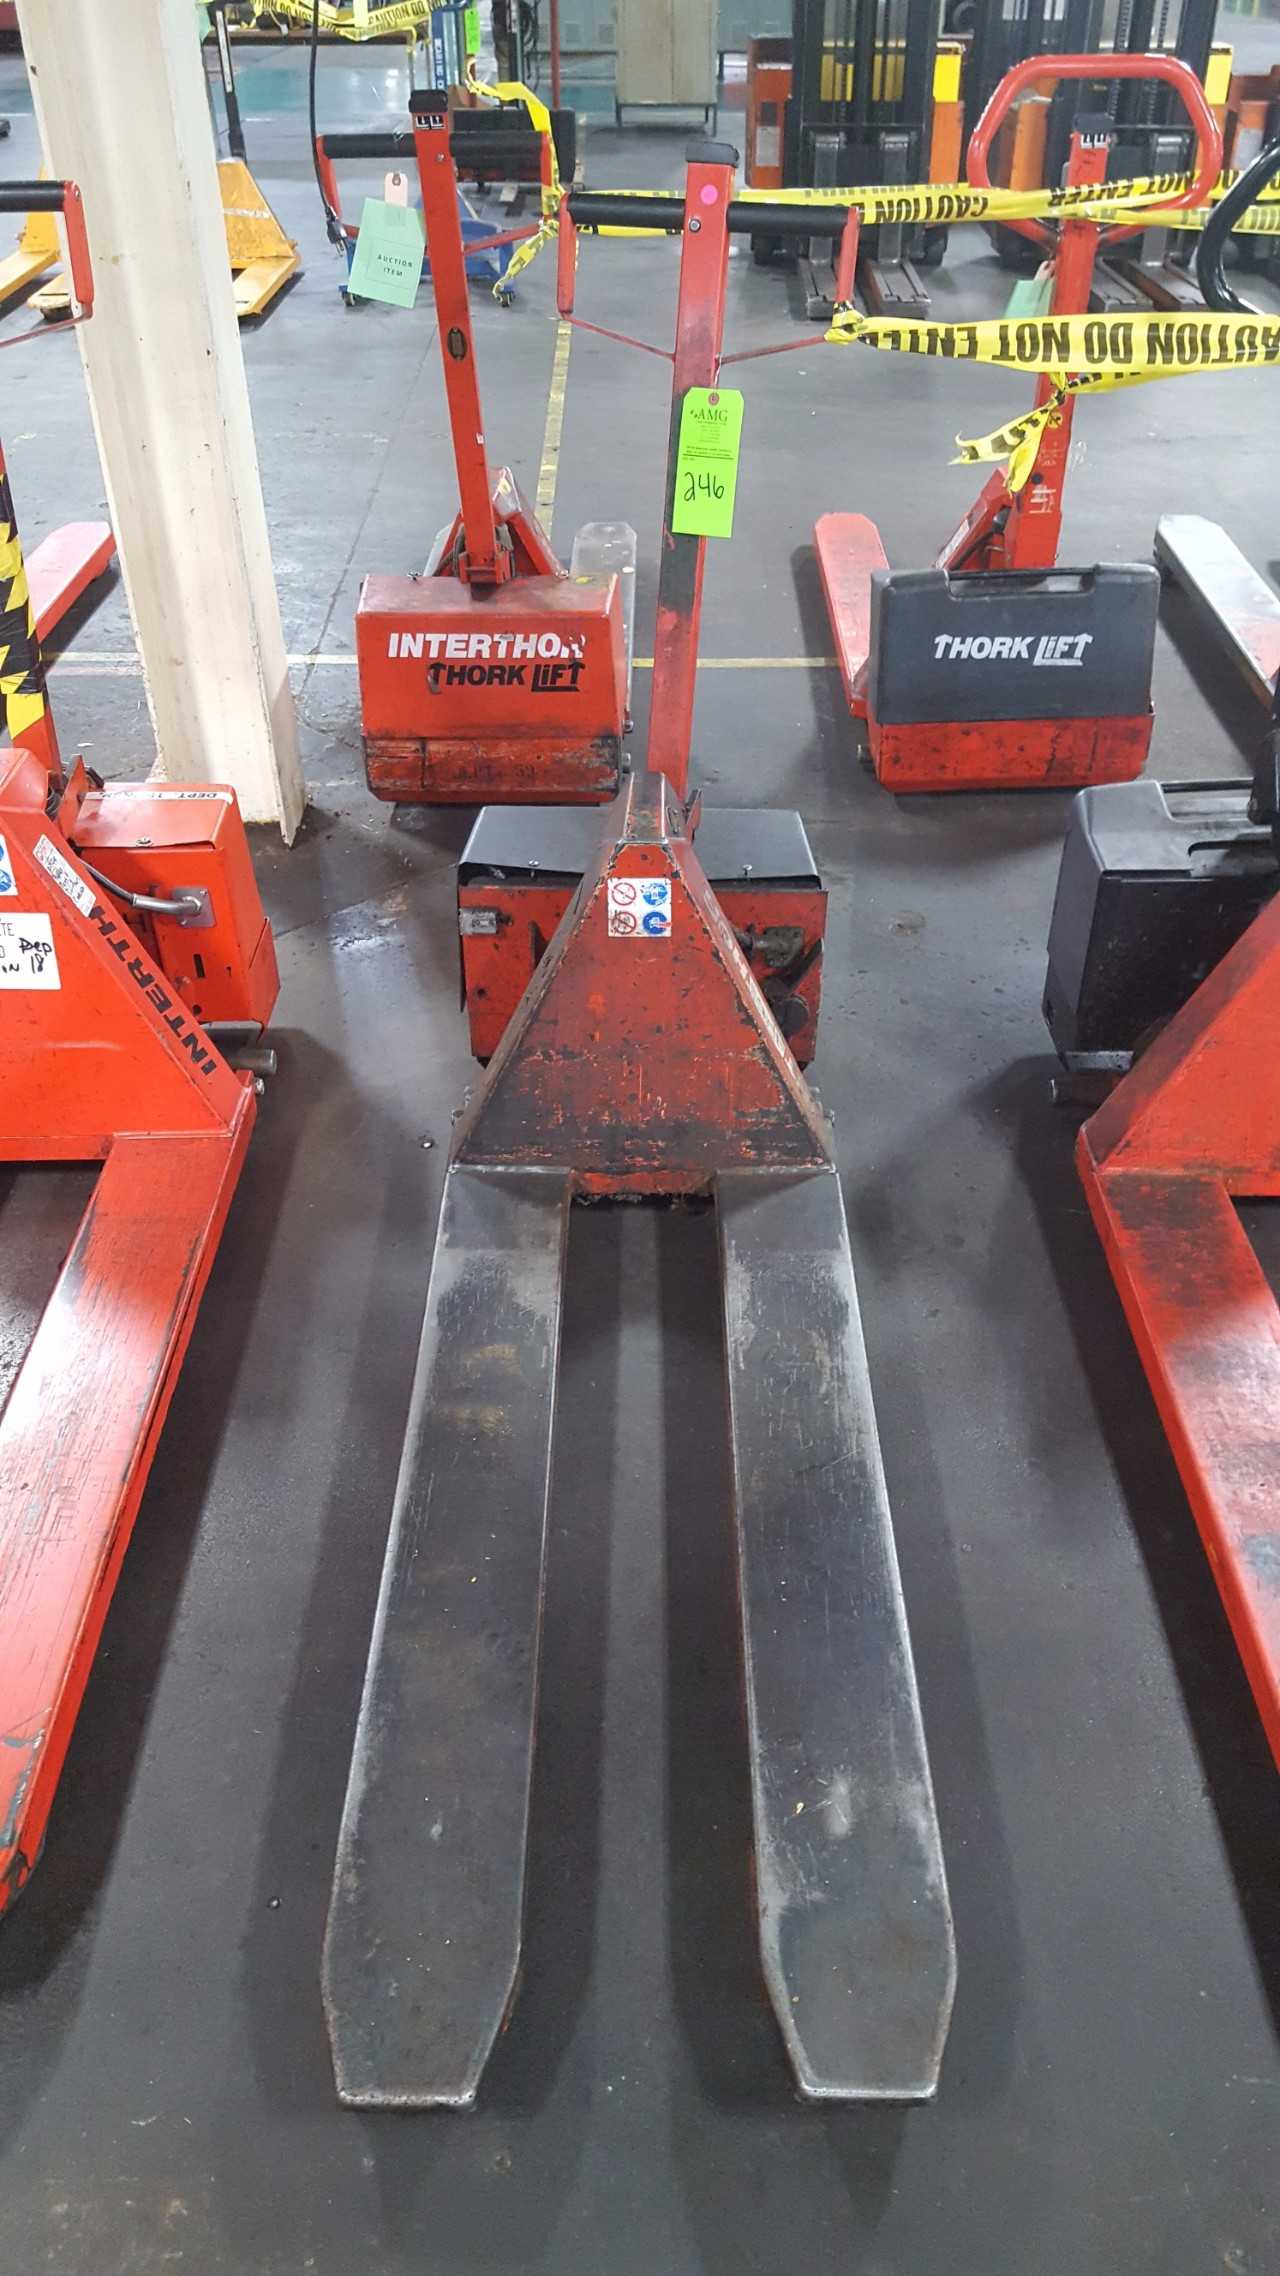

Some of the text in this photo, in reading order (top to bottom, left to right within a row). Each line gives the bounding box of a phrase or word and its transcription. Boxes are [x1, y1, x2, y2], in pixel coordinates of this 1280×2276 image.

[875, 194, 989, 223] CAUTION
[377, 253, 413, 267] AUCTION
[383, 267, 403, 277] ITEM
[992, 321, 1070, 364] NOT
[1084, 321, 1133, 364] DO
[697, 407, 728, 422] AMG
[683, 471, 726, 502] 246
[934, 633, 1035, 660] THORK
[428, 662, 525, 687] THORK
